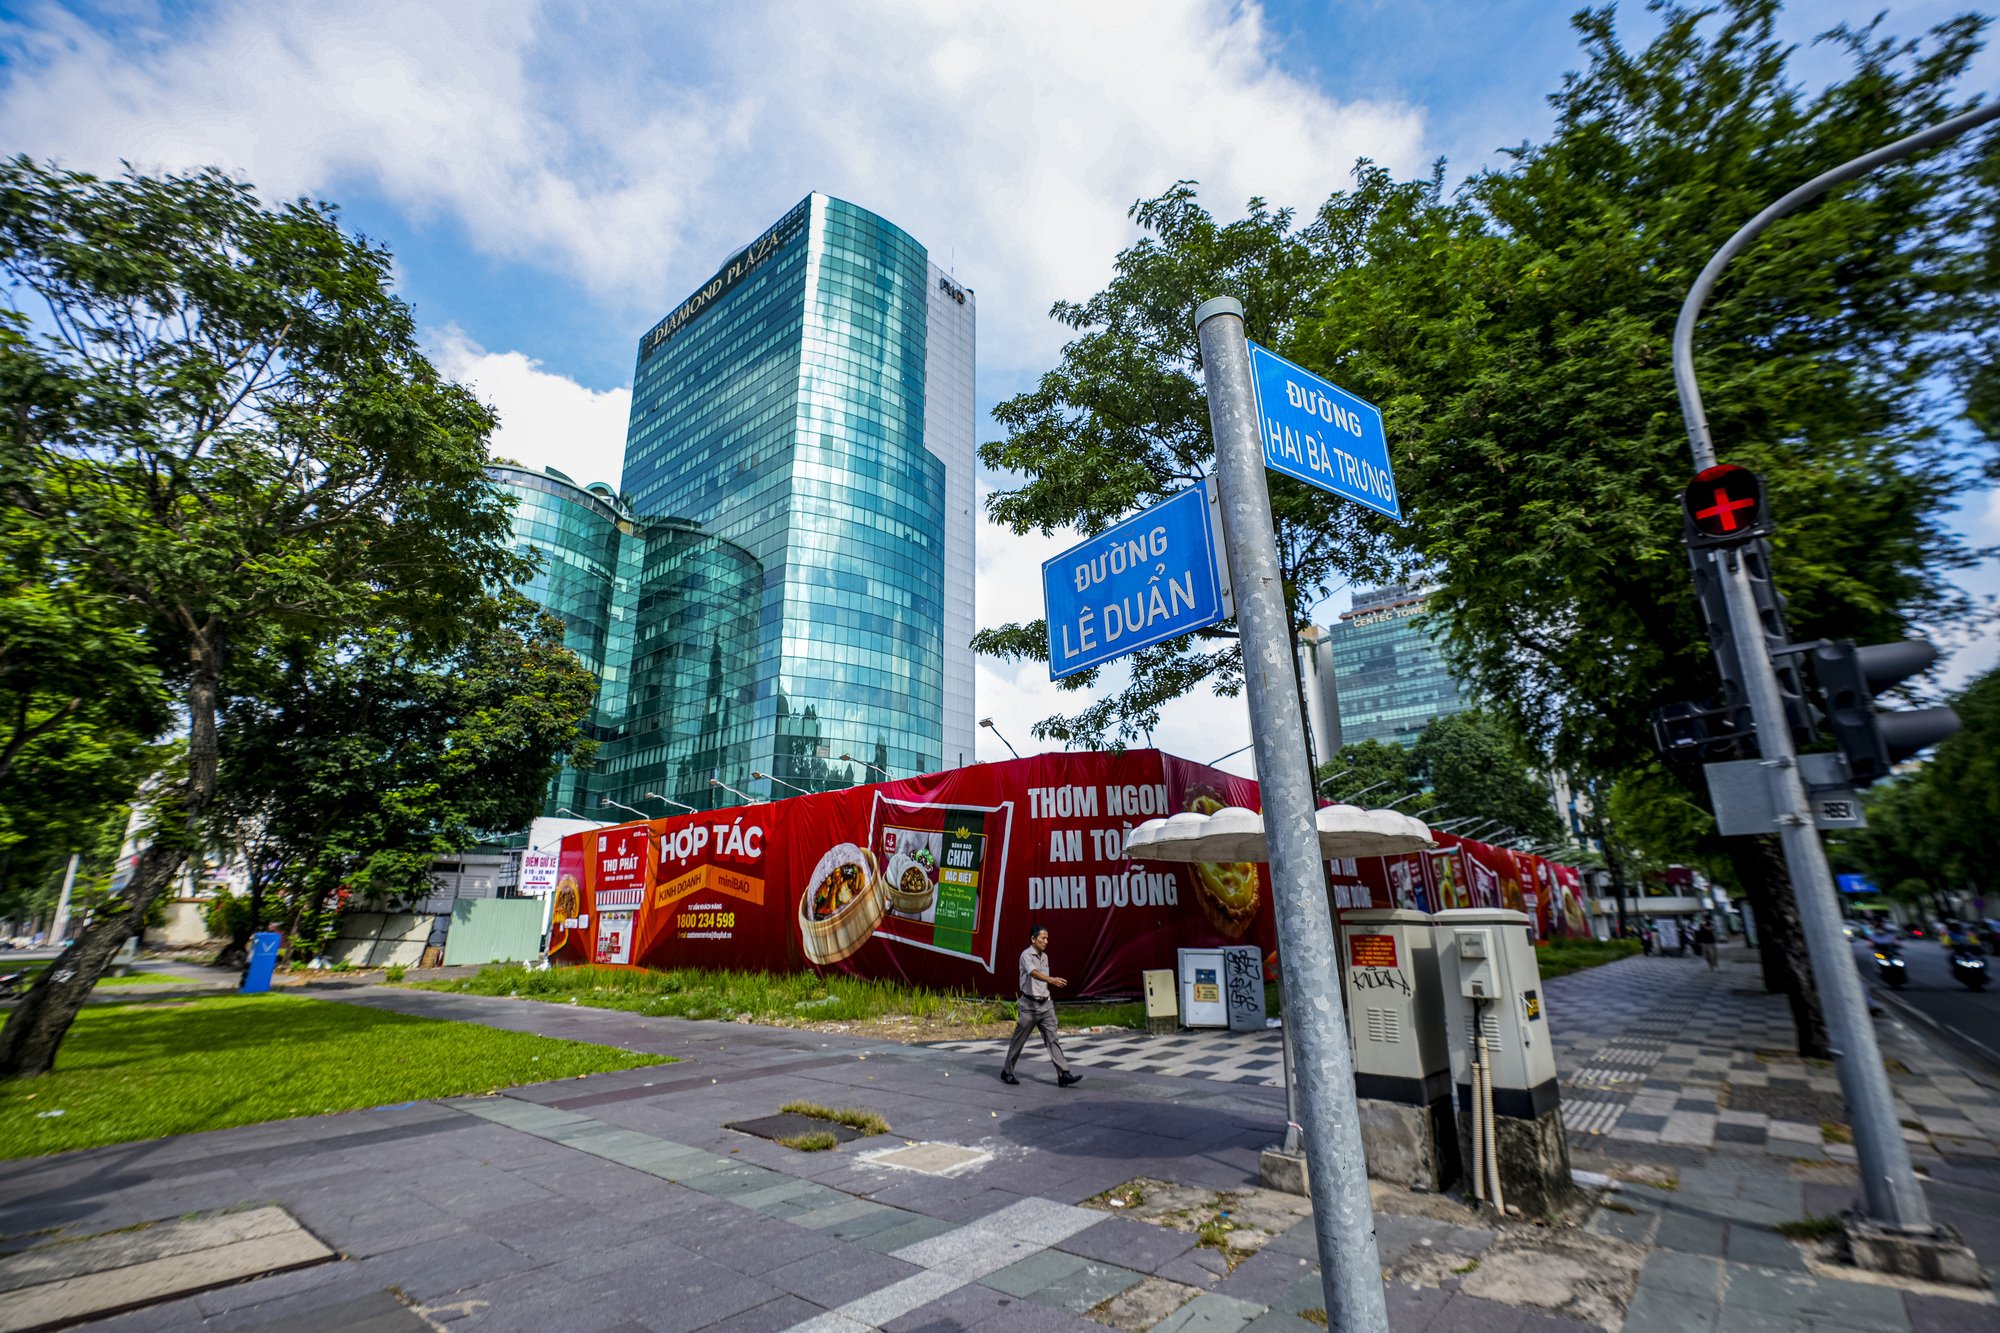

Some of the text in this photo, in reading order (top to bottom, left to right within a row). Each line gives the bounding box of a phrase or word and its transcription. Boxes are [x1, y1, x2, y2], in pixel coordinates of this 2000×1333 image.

[654, 232, 779, 344] DIAMOND PLAZA
[1286, 380, 1362, 438] ĐƯỜNG
[1267, 417, 1392, 502] HAI BÀ TRƯNG
[1074, 526, 1168, 593] ĐƯỜNG
[1063, 563, 1195, 659] LÊ DUẨN
[1354, 612, 1393, 627] CENTEC
[1028, 784, 1169, 819] THƠM NGON
[661, 817, 763, 866] HỢP TÁC
[1050, 830, 1083, 862] AN
[525, 853, 539, 867] ĐIỂM
[550, 857, 557, 867] XE
[603, 853, 639, 874] THỌ PHÁT
[946, 849, 974, 867] CHAY
[659, 873, 701, 902] KINH DOANH
[718, 875, 750, 893] miniBAO
[945, 870, 973, 885] ĐẶC BIỆT
[1028, 865, 1178, 910] DINH DƯỠNG
[677, 912, 735, 928] 1800 234 598
